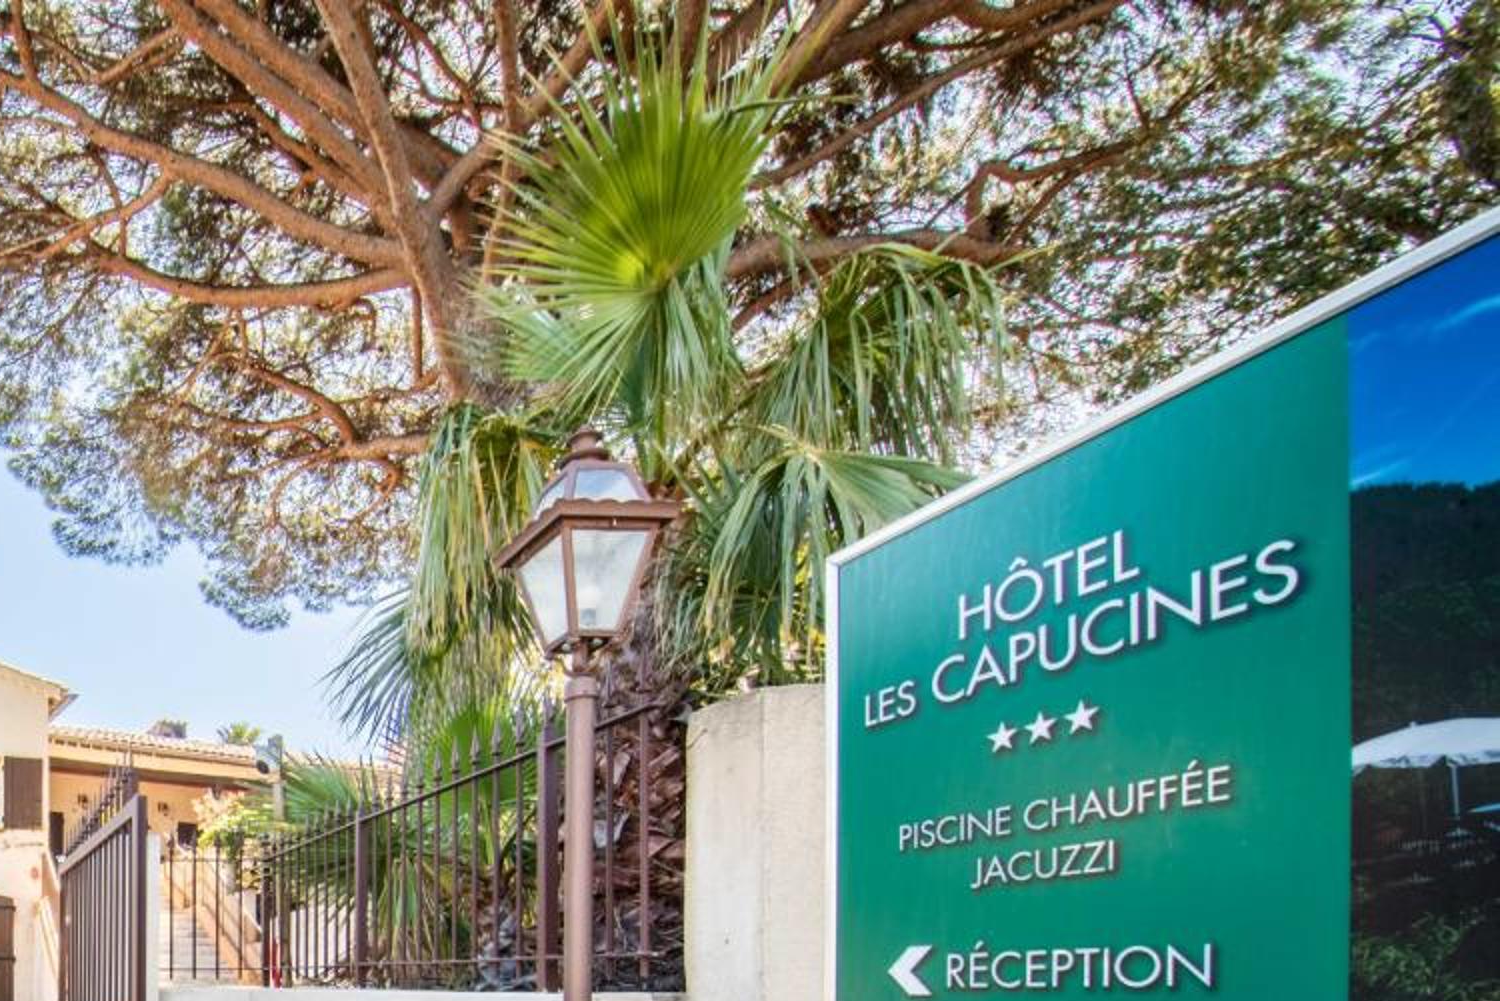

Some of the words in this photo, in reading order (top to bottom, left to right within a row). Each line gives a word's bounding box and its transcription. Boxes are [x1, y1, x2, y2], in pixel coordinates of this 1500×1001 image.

[958, 530, 1140, 640] HÔTEL
[864, 681, 916, 727] LES
[931, 539, 1300, 703] CAPUCINES
[899, 805, 1012, 851] PISCINE
[1023, 760, 1231, 832] CHAUFFÉE
[971, 839, 1115, 890] JACUZZI
[946, 941, 1214, 989] RÉCEPTION
